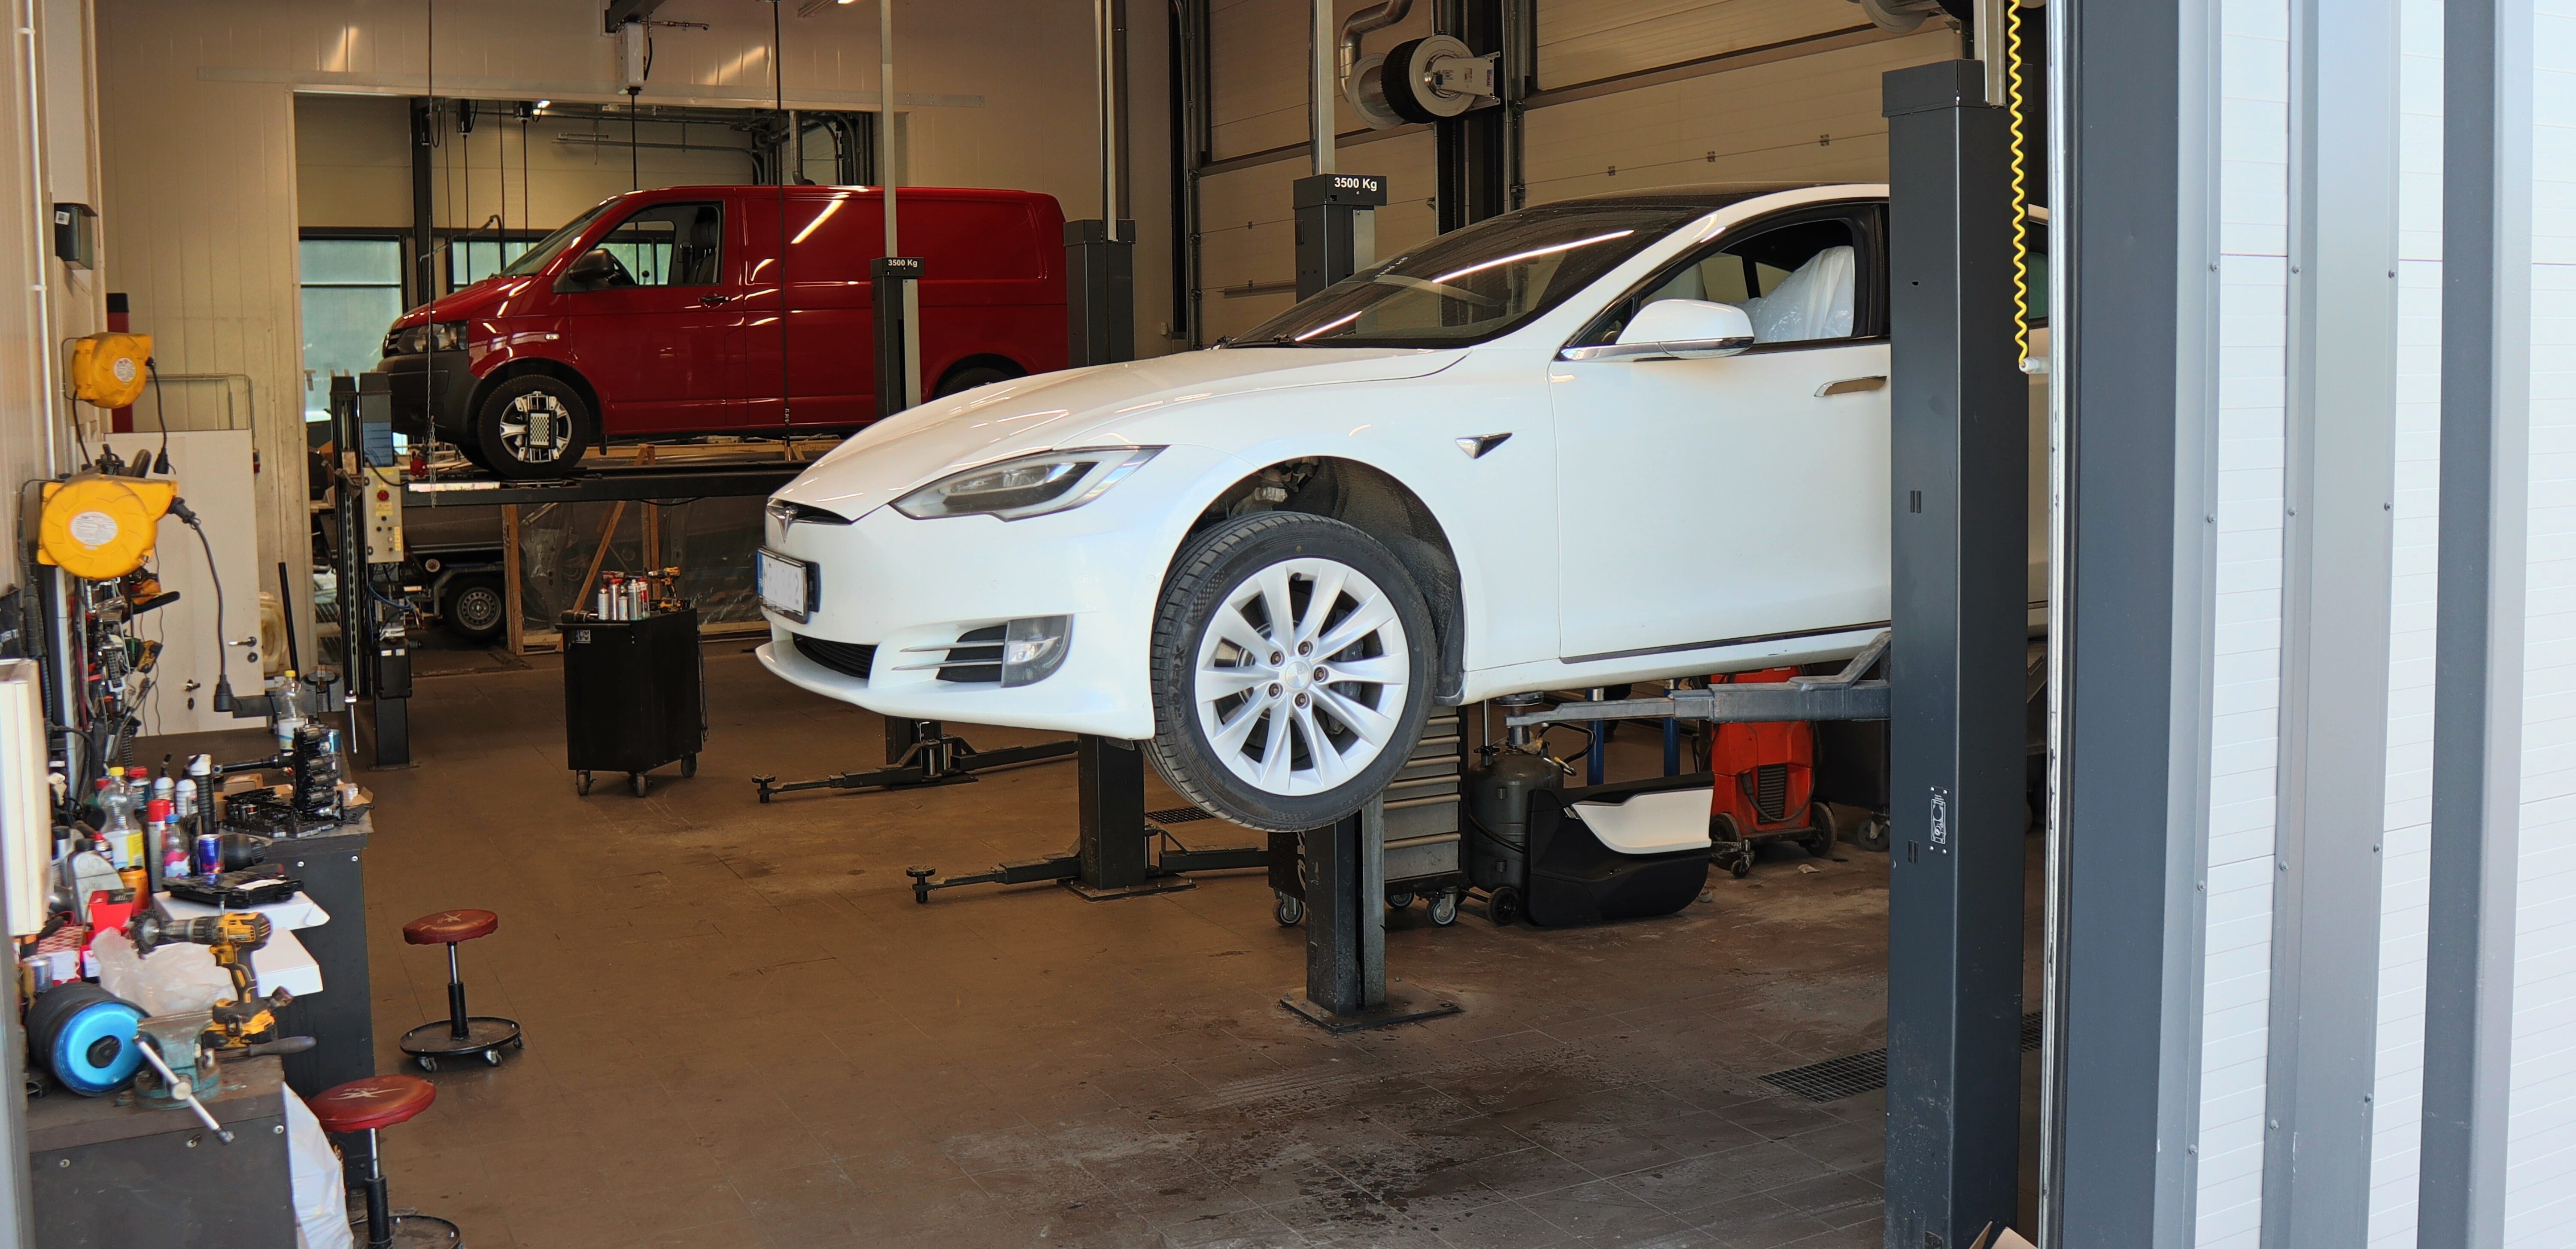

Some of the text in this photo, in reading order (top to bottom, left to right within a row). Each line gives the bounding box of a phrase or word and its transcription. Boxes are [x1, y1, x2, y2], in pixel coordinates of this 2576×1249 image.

[1334, 177, 1378, 191] 3500 Kg
[907, 259, 918, 268] Kg
[1172, 644, 1186, 720] ROADX
